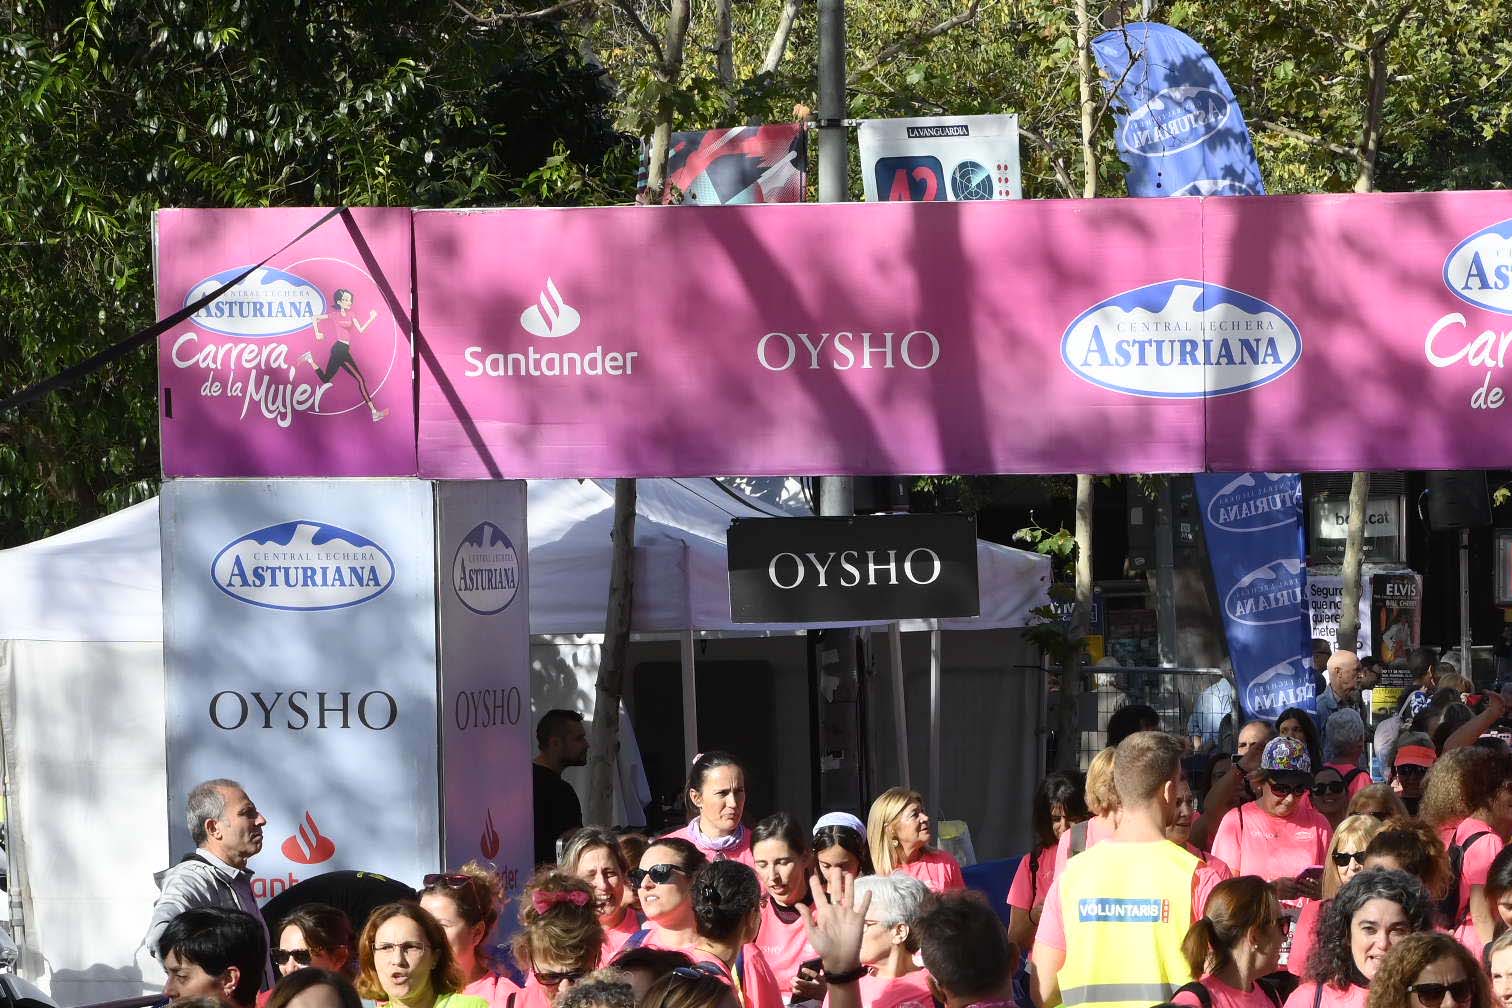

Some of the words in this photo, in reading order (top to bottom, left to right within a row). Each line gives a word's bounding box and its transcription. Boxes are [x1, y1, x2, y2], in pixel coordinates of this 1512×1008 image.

[194, 291, 314, 319] ASTURIANA
[1116, 320, 1193, 333] CENTRAL
[1199, 319, 1276, 332] LECHERA
[171, 331, 289, 369] Carrera
[464, 345, 638, 377] Santander
[756, 329, 941, 371] OYSHO
[1080, 326, 1283, 367] ASTURIANA
[200, 370, 222, 397] de
[226, 371, 243, 397] la
[240, 364, 334, 428] Mujer
[1470, 372, 1506, 409] de
[226, 555, 381, 588] ASTURIANA
[253, 552, 312, 562] CENTRAL
[316, 551, 375, 561] LECHERA
[767, 546, 943, 590] OYSHO
[458, 557, 516, 593] ASTURIANA
[1386, 583, 1416, 596] ELVIS
[1311, 601, 1328, 613] que
[1312, 614, 1344, 625] quiere
[209, 690, 398, 730] OYSHO
[455, 686, 522, 731] OYSHO
[1080, 903, 1159, 917] VOLUNTARIS
